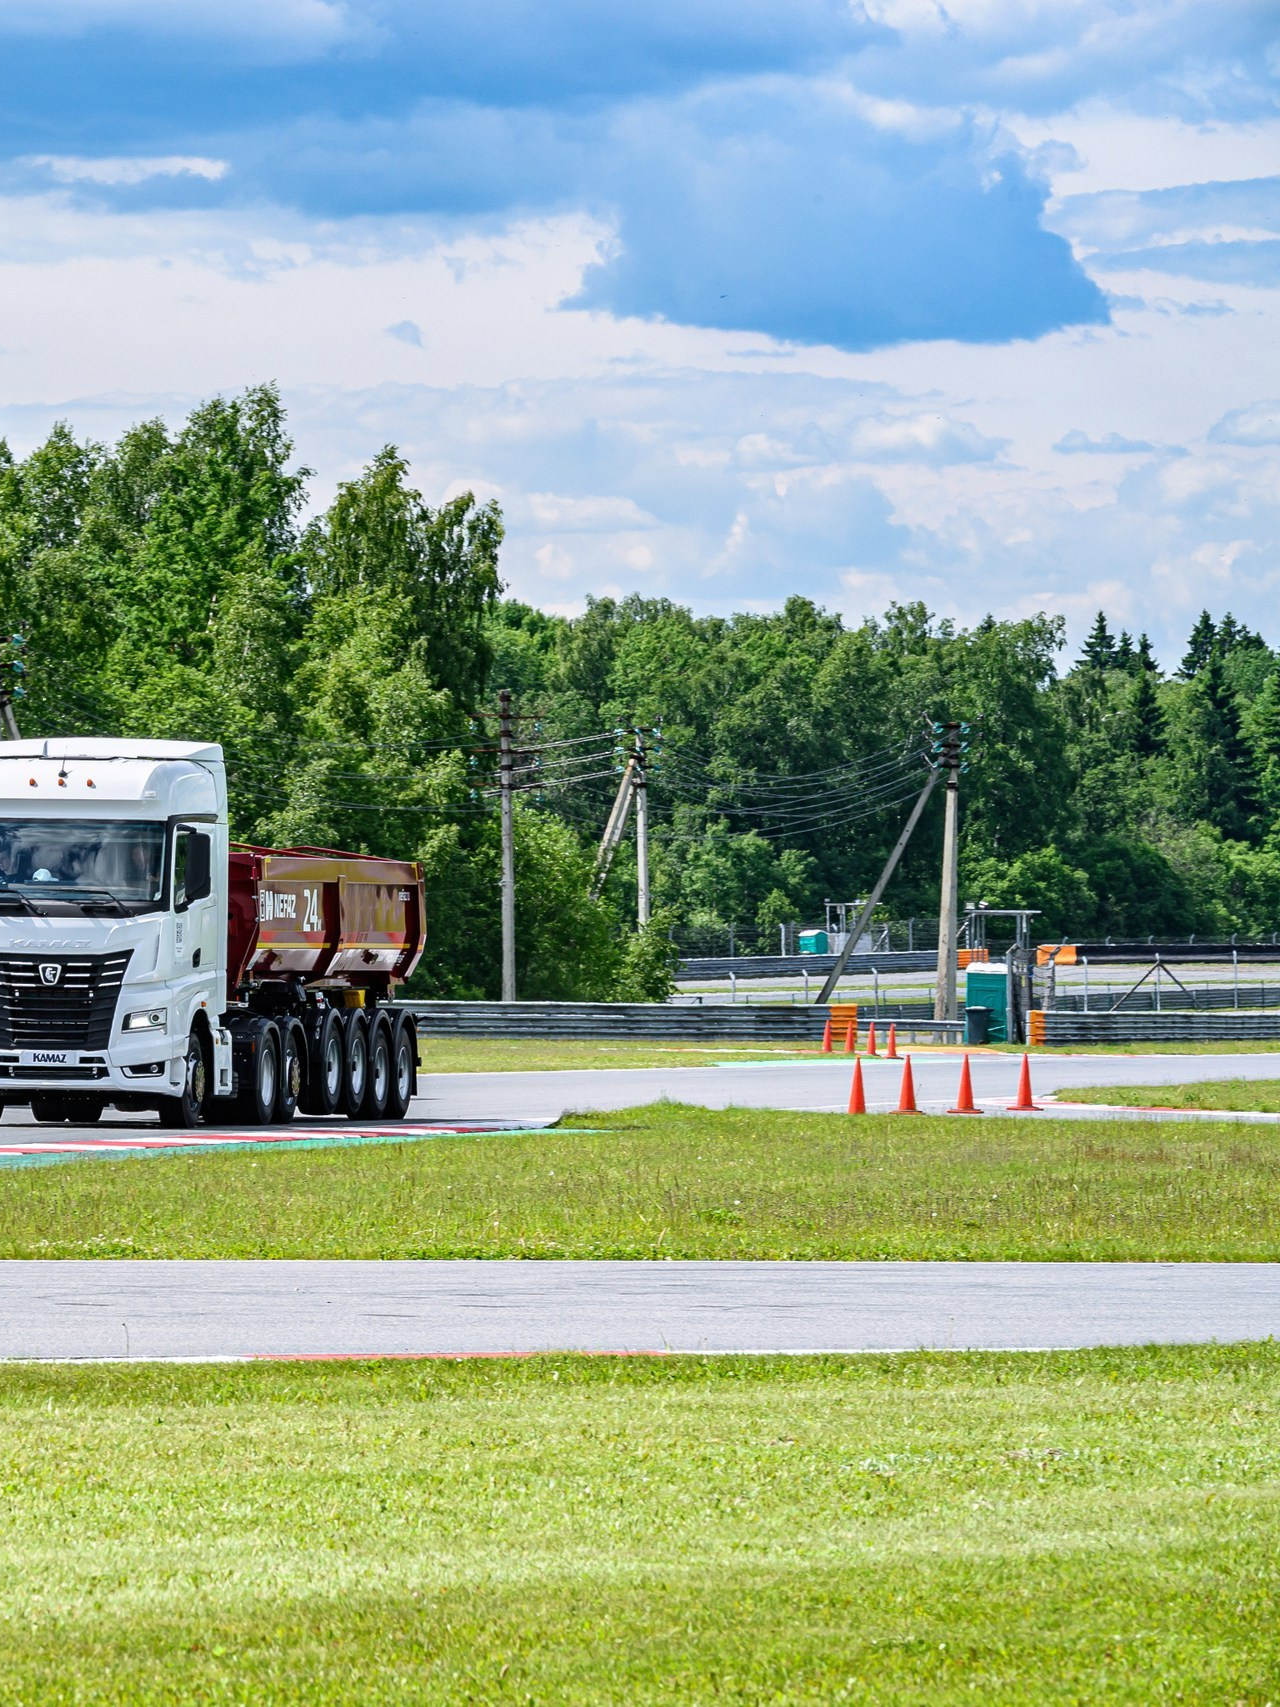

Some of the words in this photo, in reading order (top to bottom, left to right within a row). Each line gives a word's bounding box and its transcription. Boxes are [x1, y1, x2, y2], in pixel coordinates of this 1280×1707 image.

[274, 893, 296, 918] NEFAZ
[10, 939, 91, 948] KAMAZ
[33, 1053, 67, 1063] KAMAZ
